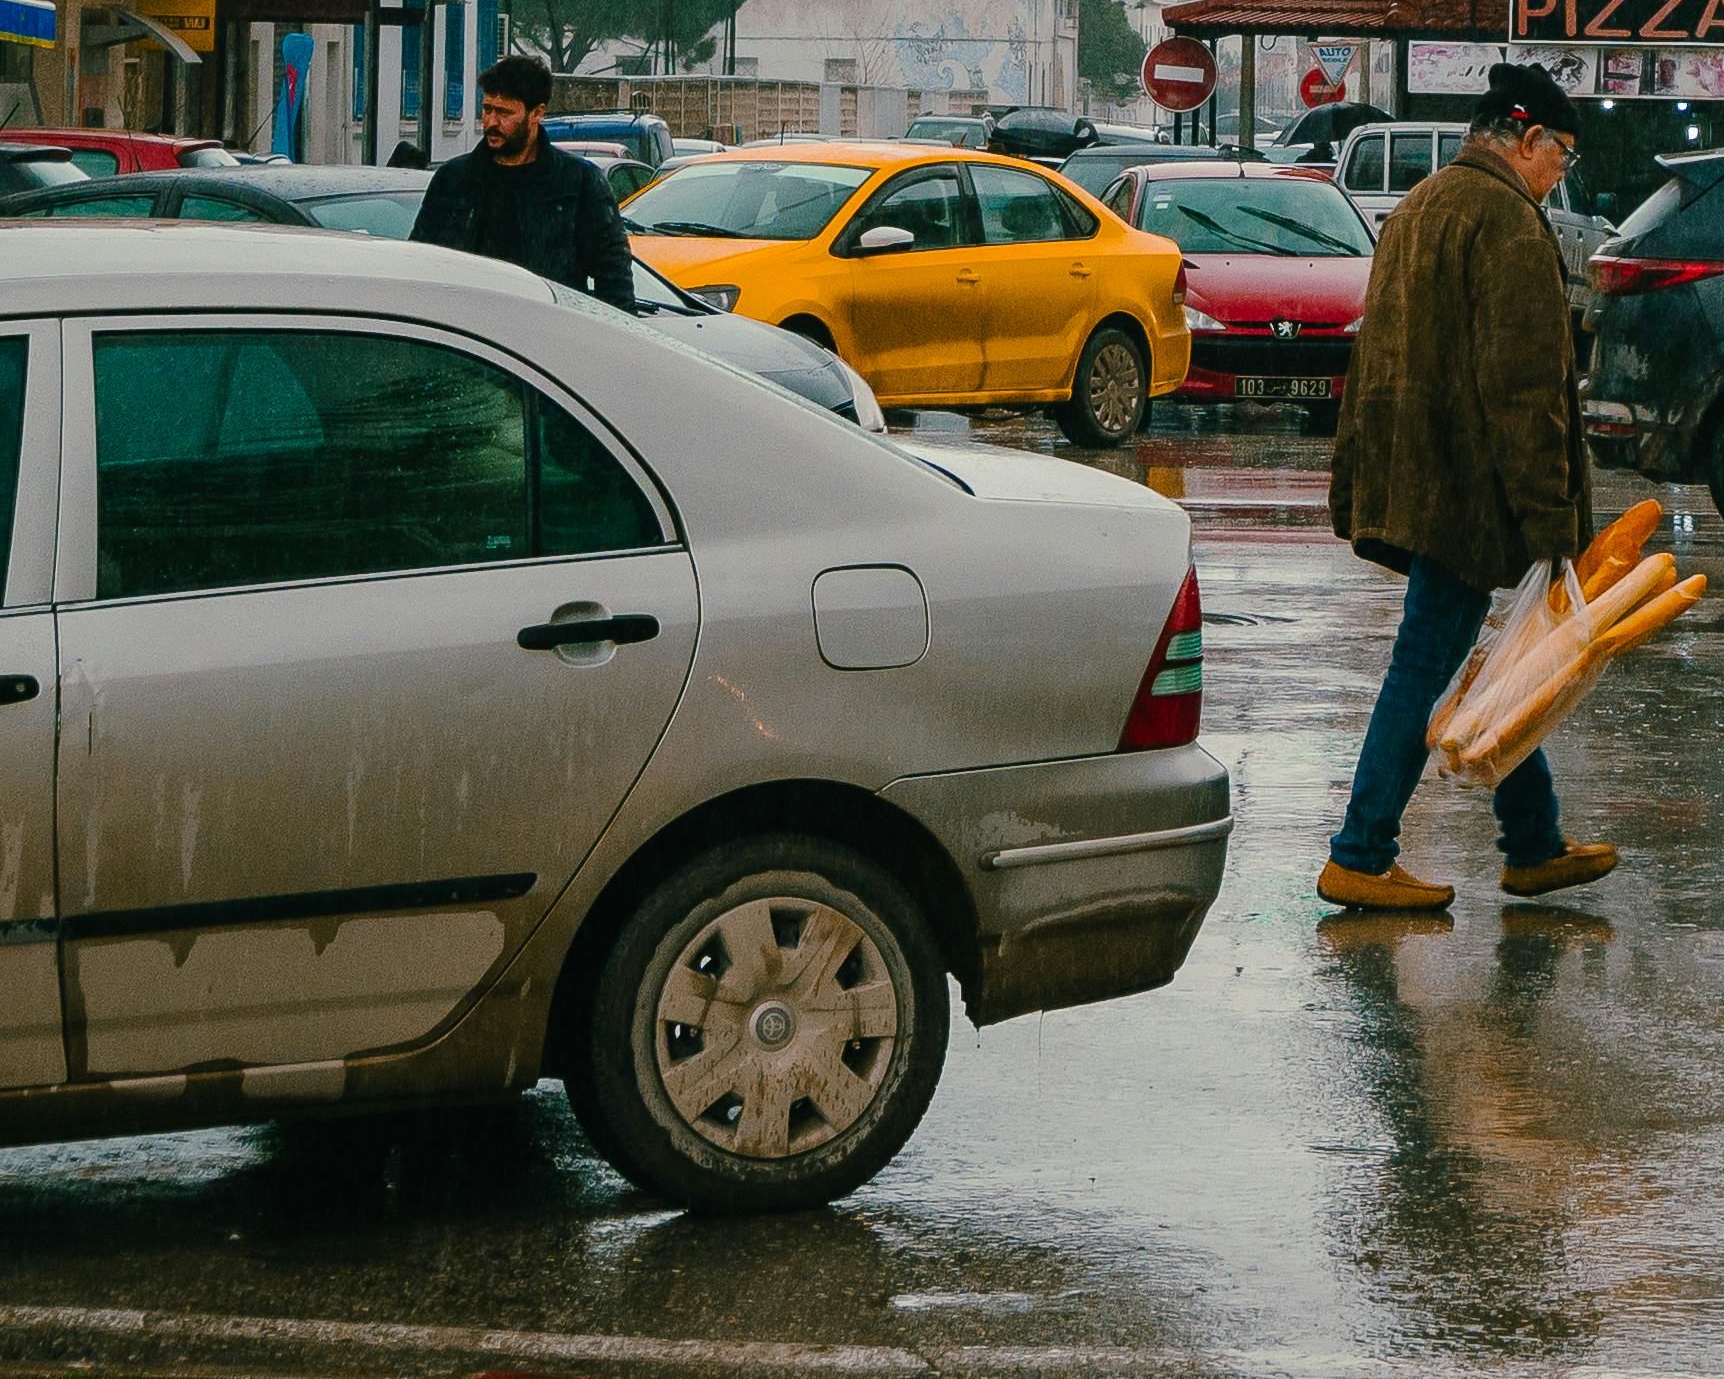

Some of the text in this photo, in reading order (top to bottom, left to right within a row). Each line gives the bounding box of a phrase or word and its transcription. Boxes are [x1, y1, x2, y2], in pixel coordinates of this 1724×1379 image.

[1319, 47, 1351, 56] AUTO
[1241, 379, 1264, 395] 103
[1291, 380, 1326, 396] 9629
